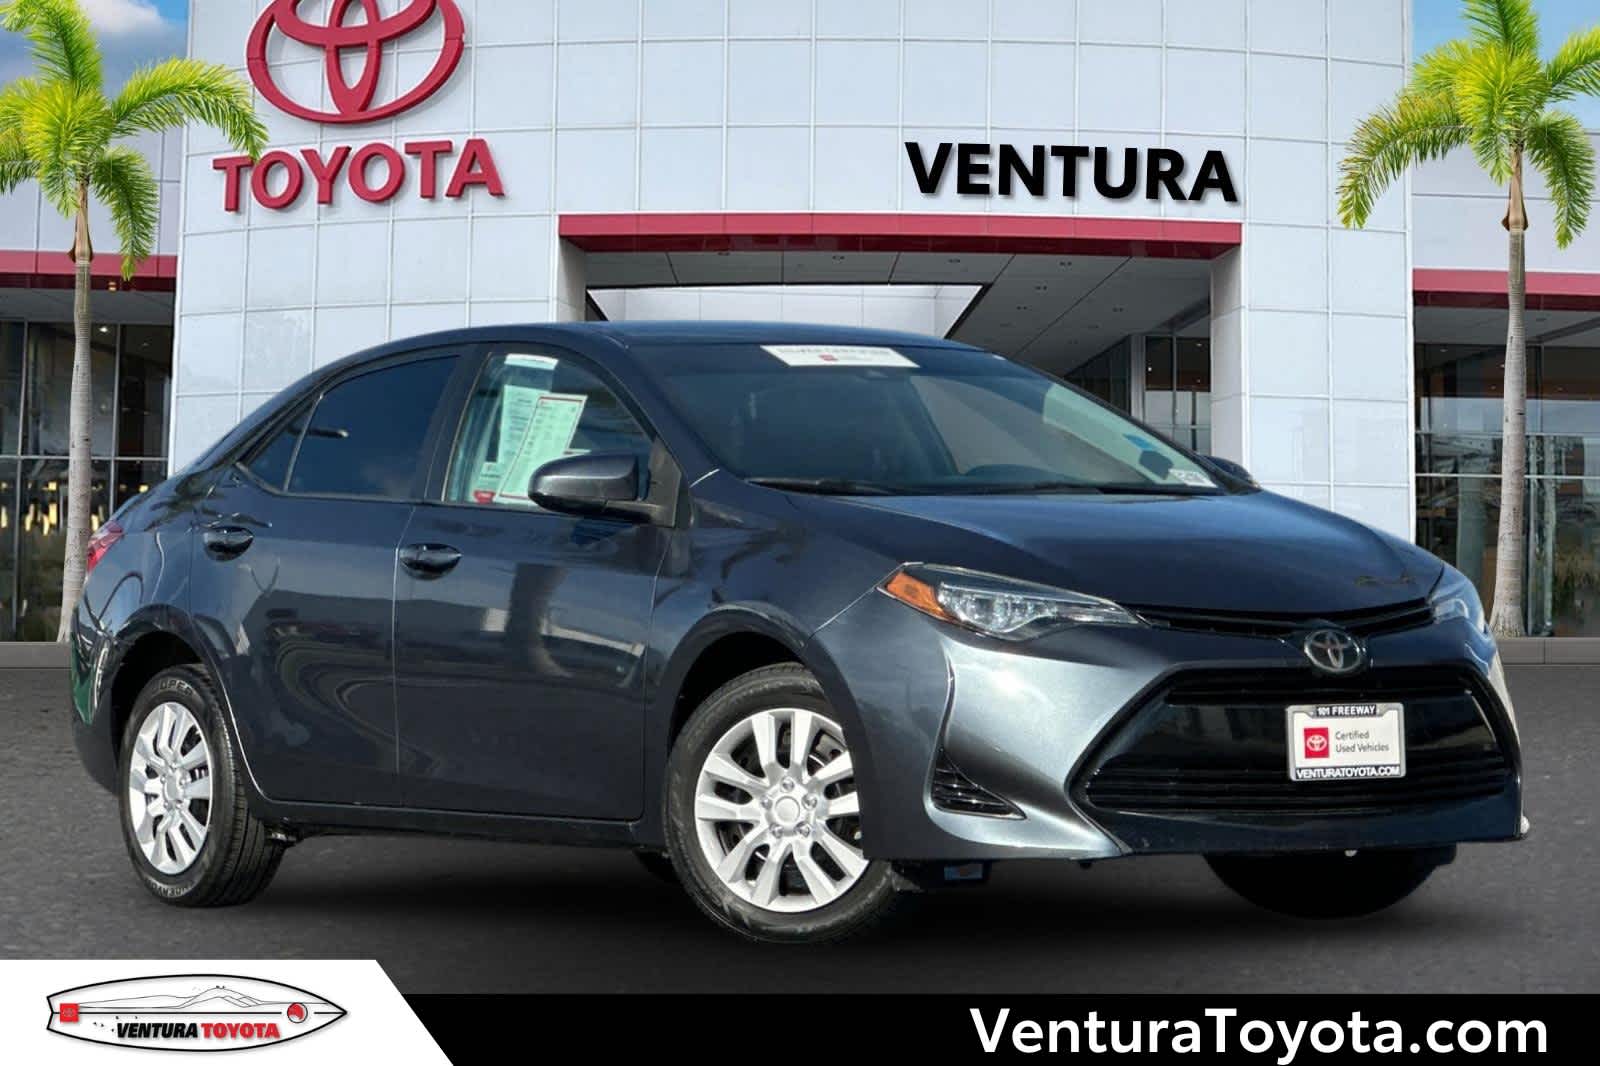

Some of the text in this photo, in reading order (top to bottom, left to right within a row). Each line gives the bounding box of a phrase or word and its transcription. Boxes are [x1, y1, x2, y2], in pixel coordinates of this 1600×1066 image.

[213, 138, 504, 211] TOYOTA
[905, 142, 1237, 203] VENTURA
[1332, 705, 1375, 715] FREEWAY
[1335, 731, 1370, 740] Certified
[1335, 743, 1389, 752] Used Vehicles
[1296, 766, 1400, 779] VENTURATOYOTA.COM
